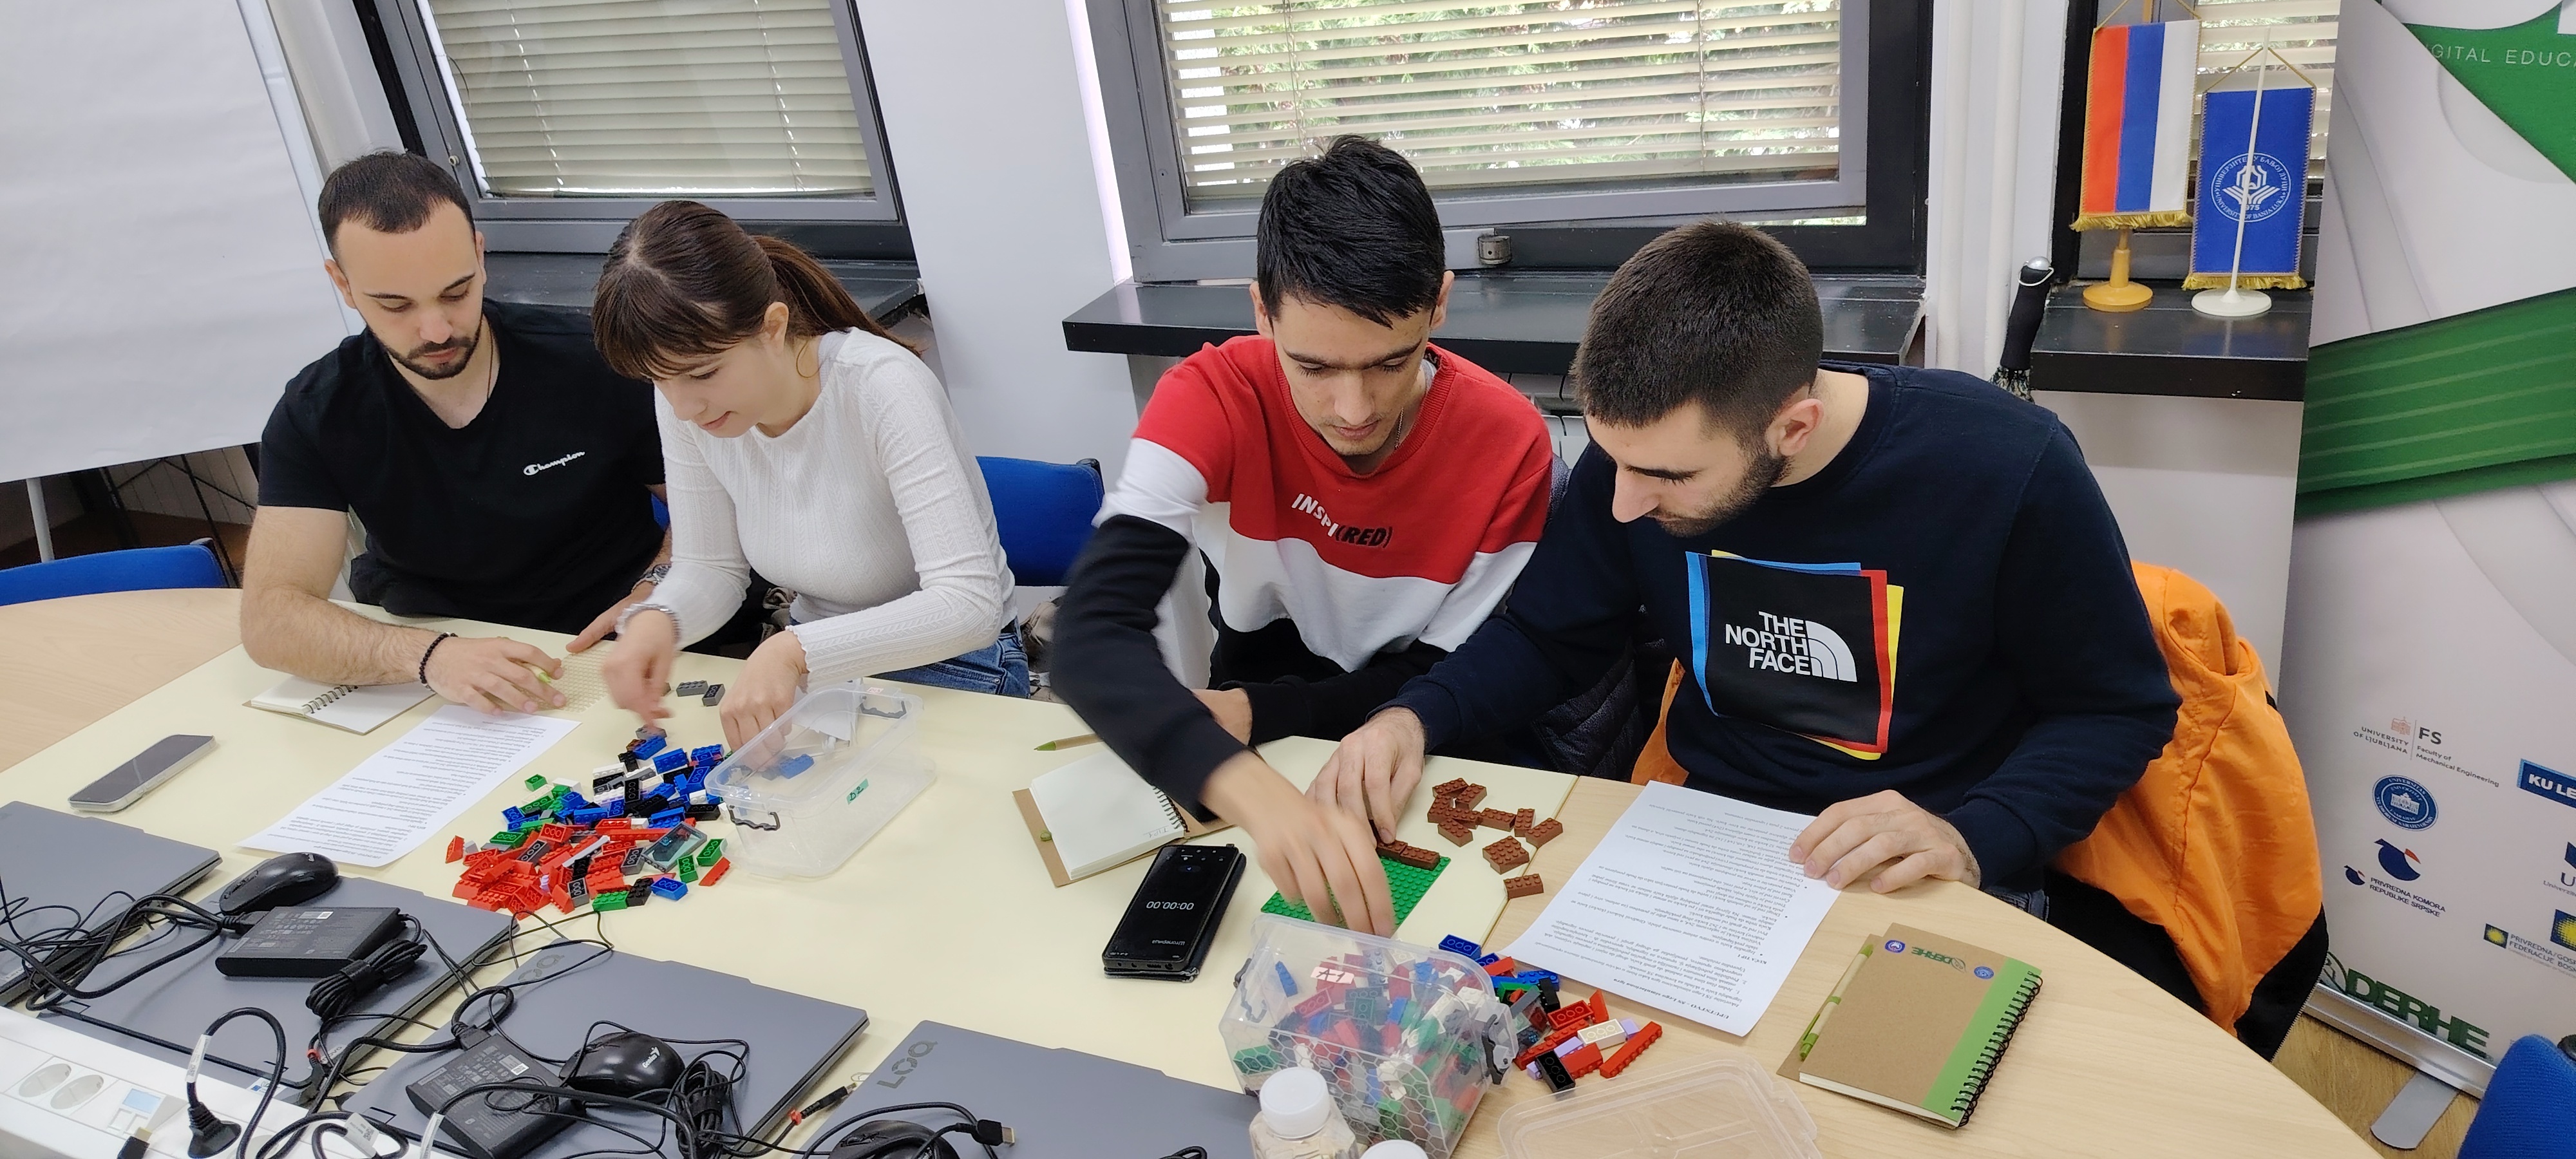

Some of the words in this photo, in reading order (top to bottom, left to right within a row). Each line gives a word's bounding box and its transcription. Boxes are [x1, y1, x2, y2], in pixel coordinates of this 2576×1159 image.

[2430, 44, 2491, 62] GITAL
[2505, 49, 2576, 67] EDUC
[2215, 194, 2240, 219] UNIVERSIT
[523, 451, 585, 476] Champion
[1758, 610, 1806, 638] THE
[1725, 623, 1808, 655] NORTH
[1749, 648, 1811, 675] FACE
[2362, 726, 2409, 746] UNIVERSITY
[2365, 735, 2408, 755] LJUBLJANA
[2418, 727, 2442, 745] FS
[2417, 746, 2443, 759] Faculty
[2416, 753, 2456, 771] Mechanical
[2456, 767, 2500, 787] Engineering
[2528, 773, 2553, 791] KU
[2556, 783, 2576, 800] LE
[2560, 872, 2576, 887] U
[2369, 884, 2410, 905] REPUBLIKE
[2410, 901, 2441, 918] SRPSKE
[2370, 877, 2412, 898] PRIVREDNA
[2412, 894, 2446, 912] KOMORA
[2345, 968, 2490, 1059] DERHE
[876, 1040, 938, 1089] LOQ
